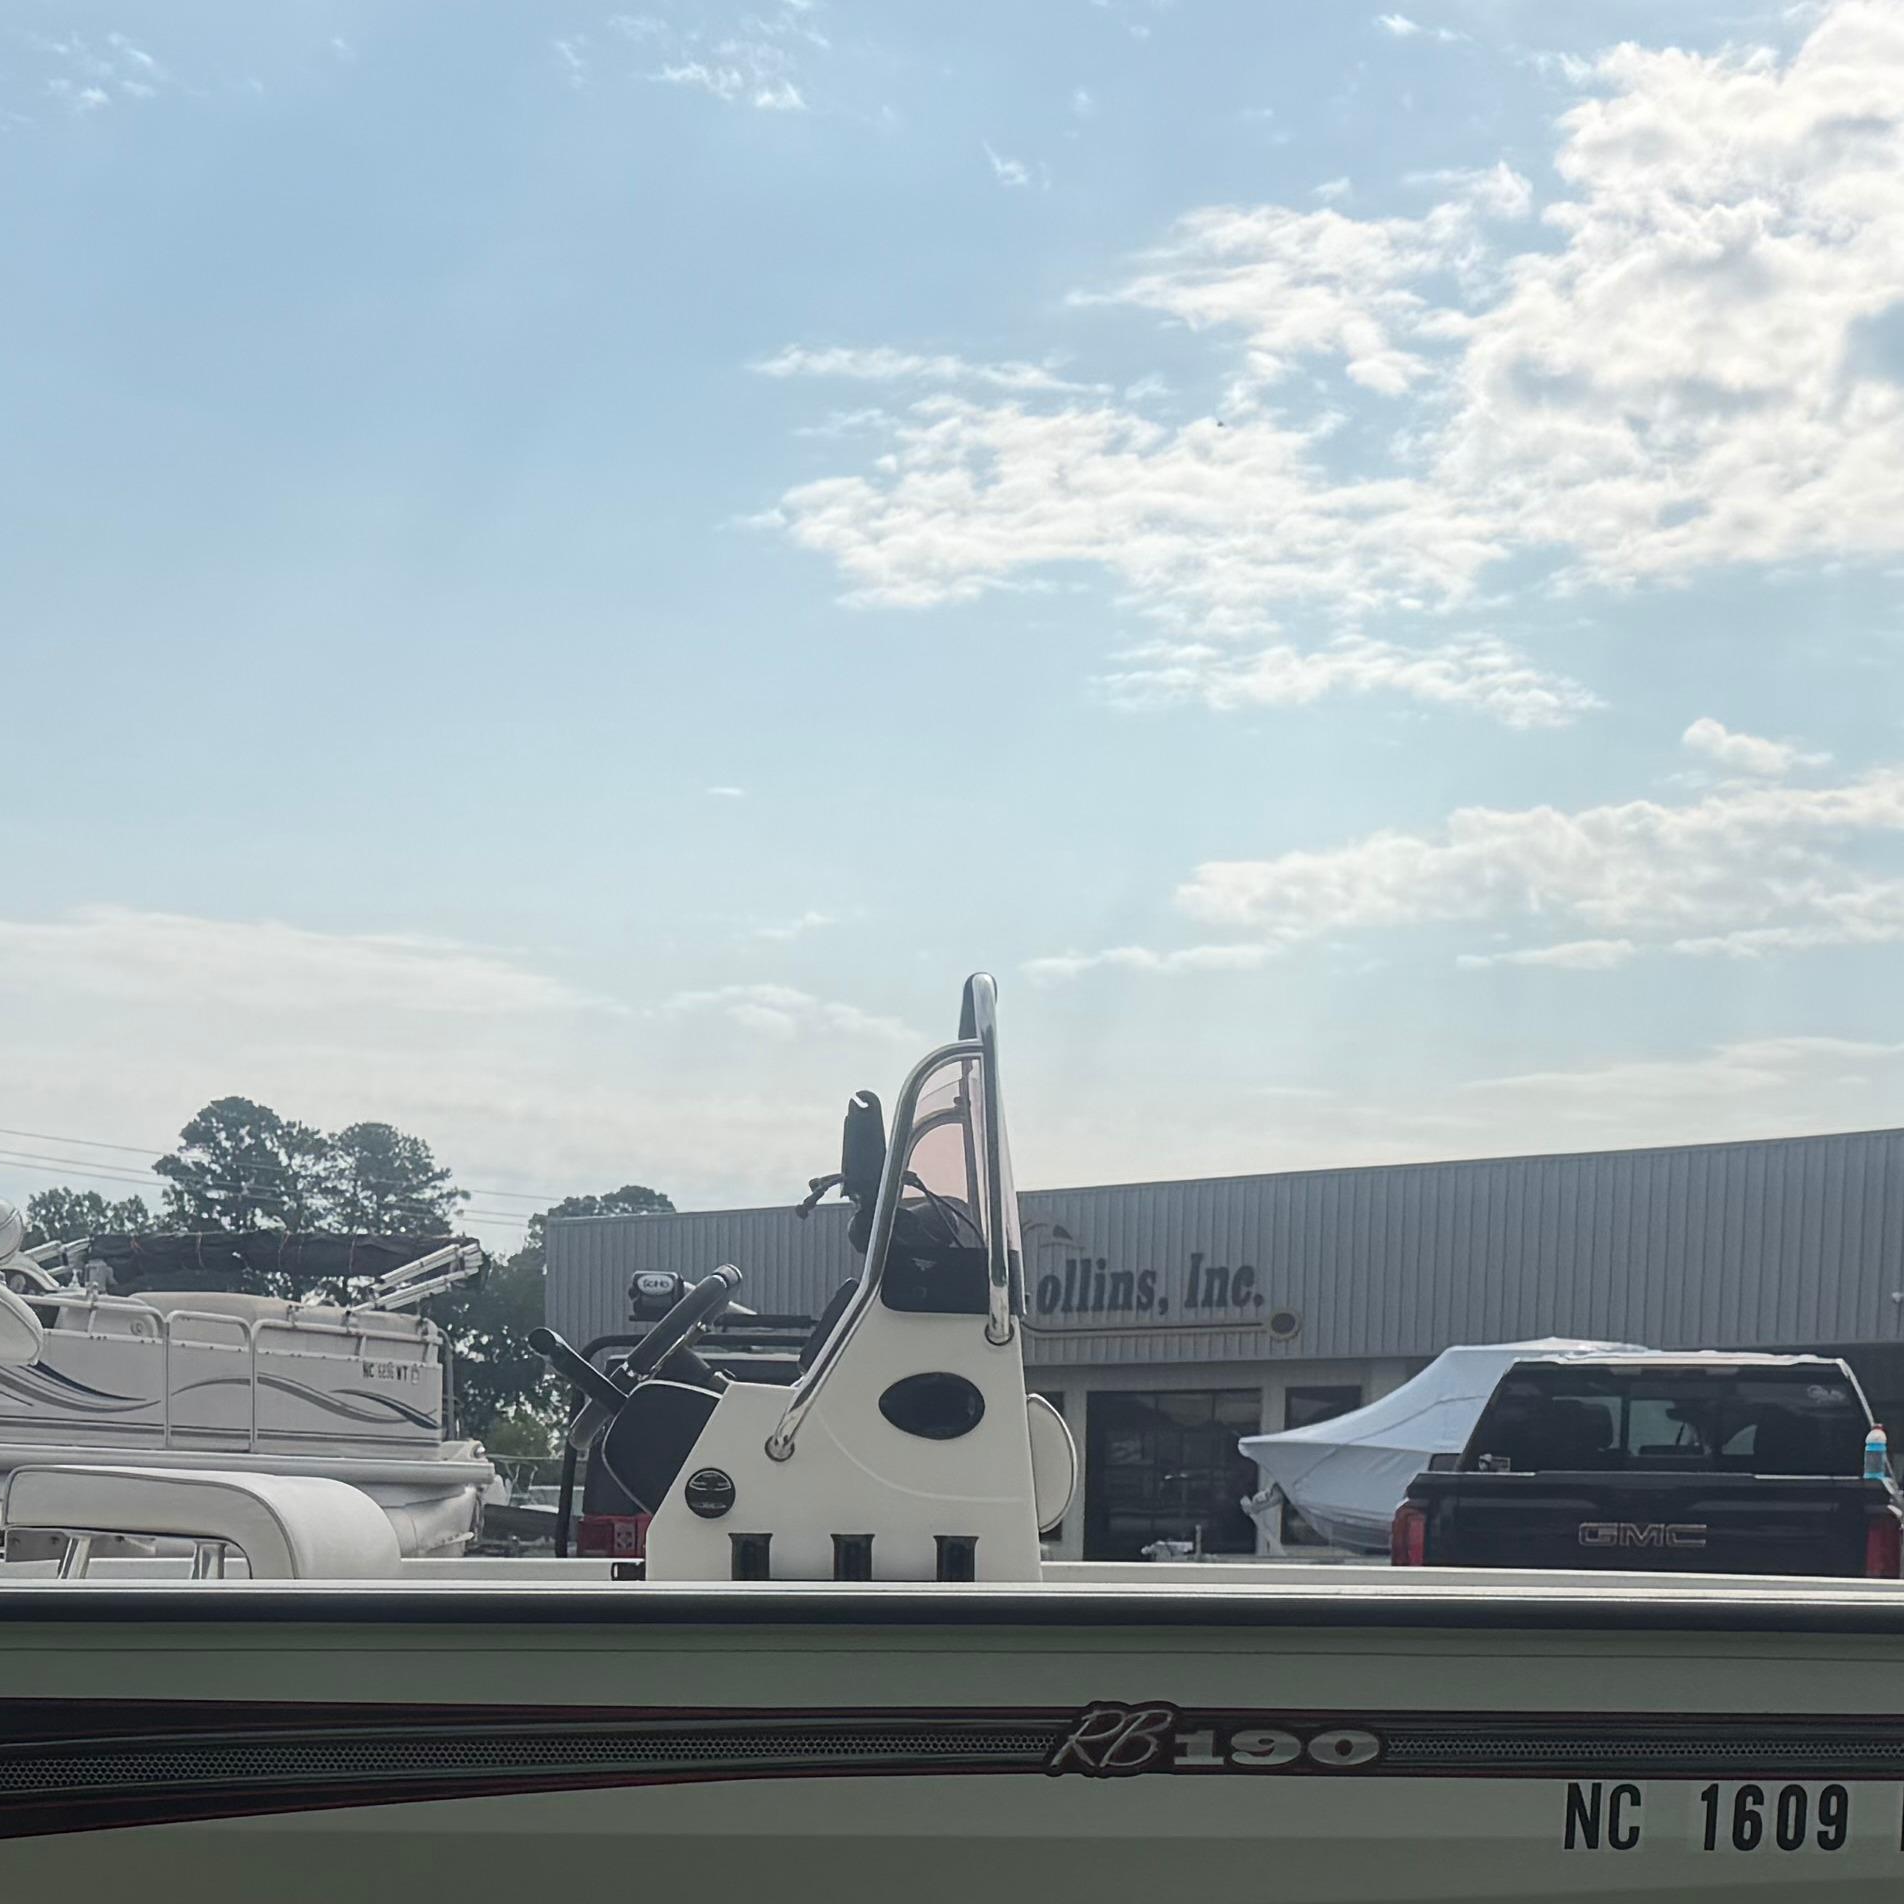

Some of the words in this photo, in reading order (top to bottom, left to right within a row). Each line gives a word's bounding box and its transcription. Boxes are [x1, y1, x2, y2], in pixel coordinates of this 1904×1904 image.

[1025, 1257, 1170, 1316] ollins,
[1184, 1252, 1265, 1309] Inc.
[1578, 1522, 1708, 1547] GMC
[1563, 1782, 1642, 1851] NC
[1700, 1782, 1851, 1852] 1609
